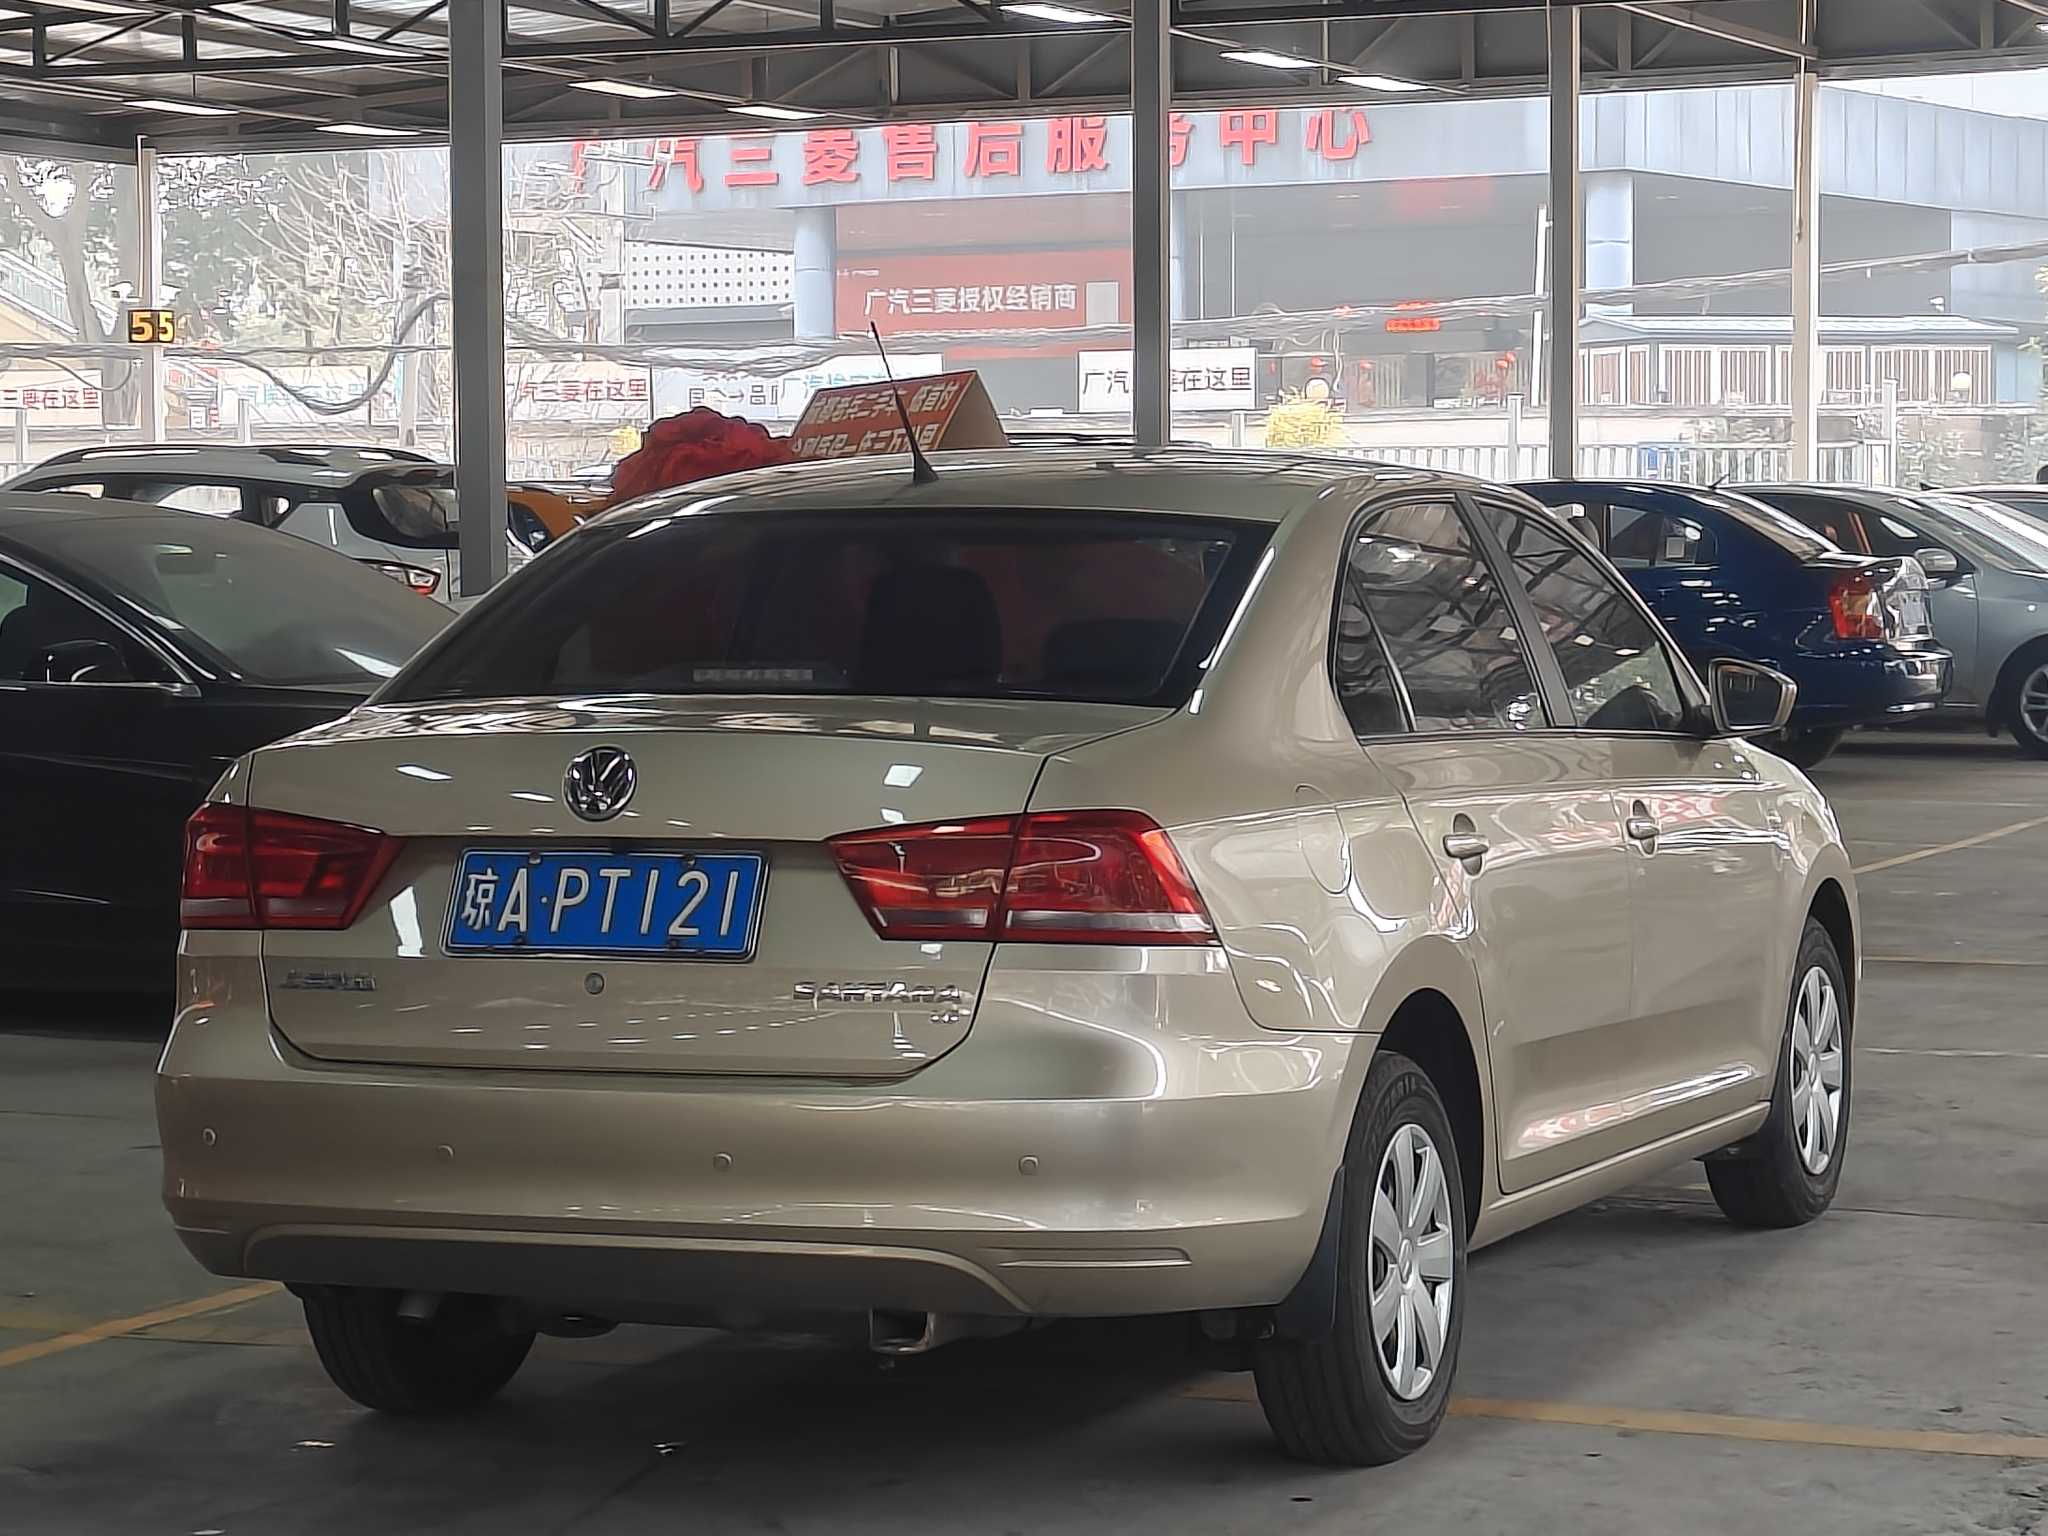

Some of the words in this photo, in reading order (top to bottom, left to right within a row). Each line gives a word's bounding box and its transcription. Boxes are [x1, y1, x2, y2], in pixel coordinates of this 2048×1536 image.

[864, 284, 1077, 315] 广汽三菱授权经销商
[131, 310, 174, 342] 55
[1083, 367, 1252, 394] 广汽在这里
